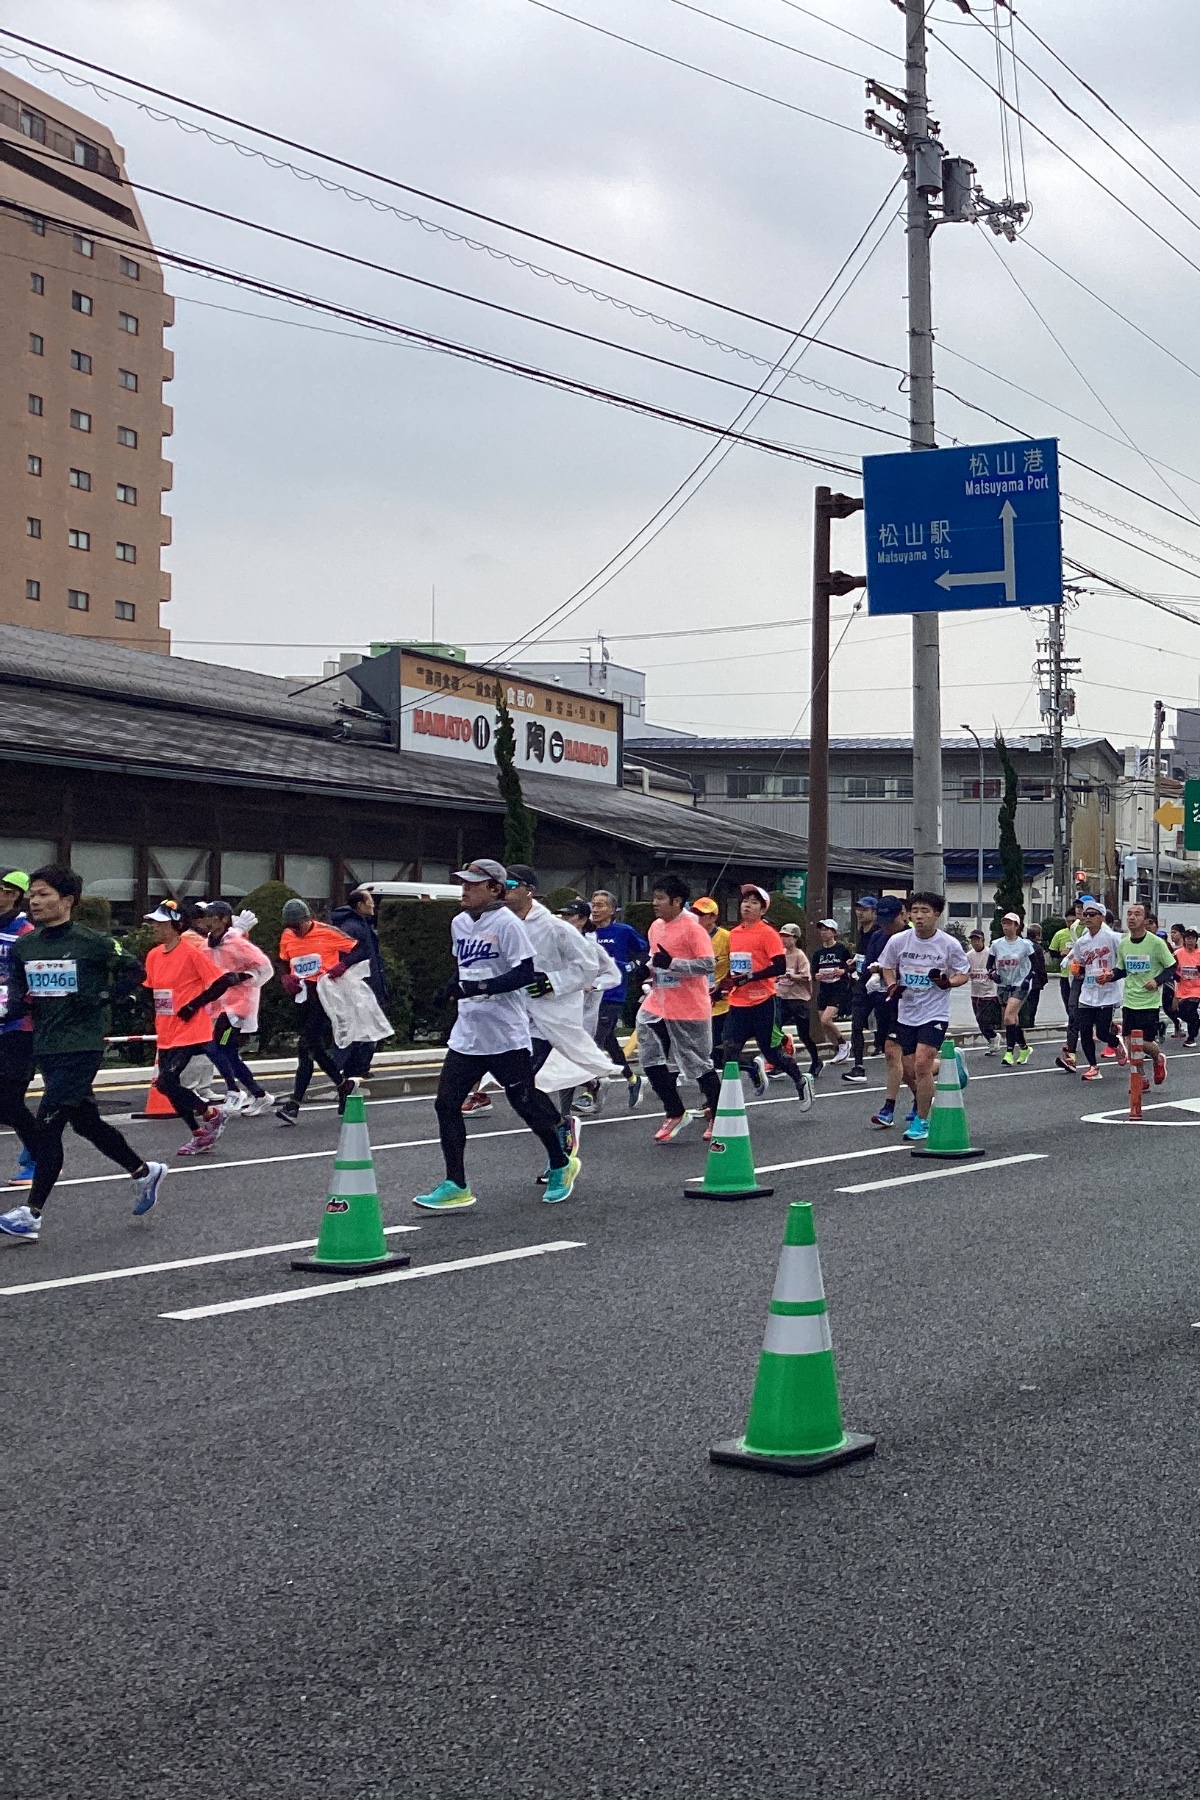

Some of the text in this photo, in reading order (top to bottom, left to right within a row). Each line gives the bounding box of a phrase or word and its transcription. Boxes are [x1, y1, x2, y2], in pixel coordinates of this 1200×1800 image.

[969, 448, 1044, 478] 松山港
[965, 474, 1049, 497] Matsuyama Port
[879, 520, 951, 548] 松山駅
[877, 547, 953, 564] Matsuyama Sta.
[506, 687, 535, 709] 食器の
[413, 708, 473, 742] HAMATO
[564, 739, 609, 767] HAMATO
